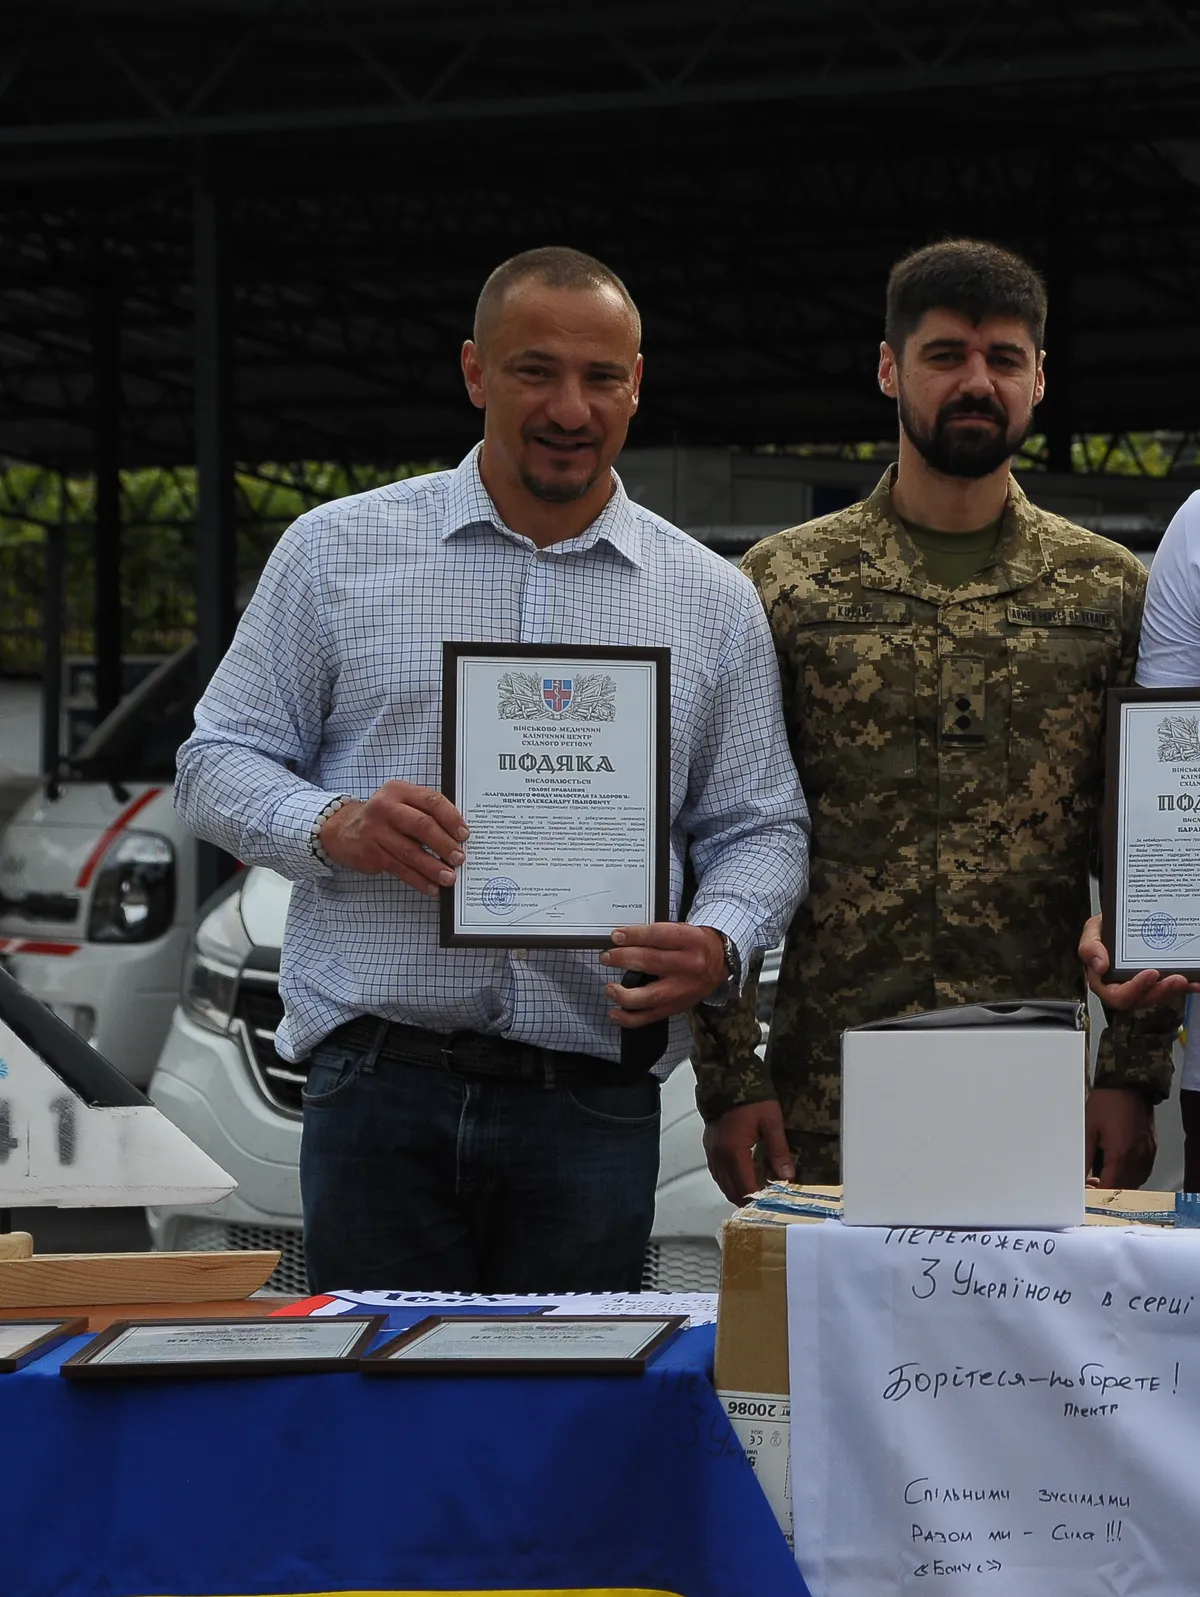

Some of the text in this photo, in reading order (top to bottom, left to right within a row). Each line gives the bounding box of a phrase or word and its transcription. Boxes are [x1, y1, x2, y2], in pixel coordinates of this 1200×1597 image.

[498, 752, 616, 774] ПОДЯКА
[1129, 1294, 1195, 1316] серці
[728, 1401, 776, 1417] 20086
